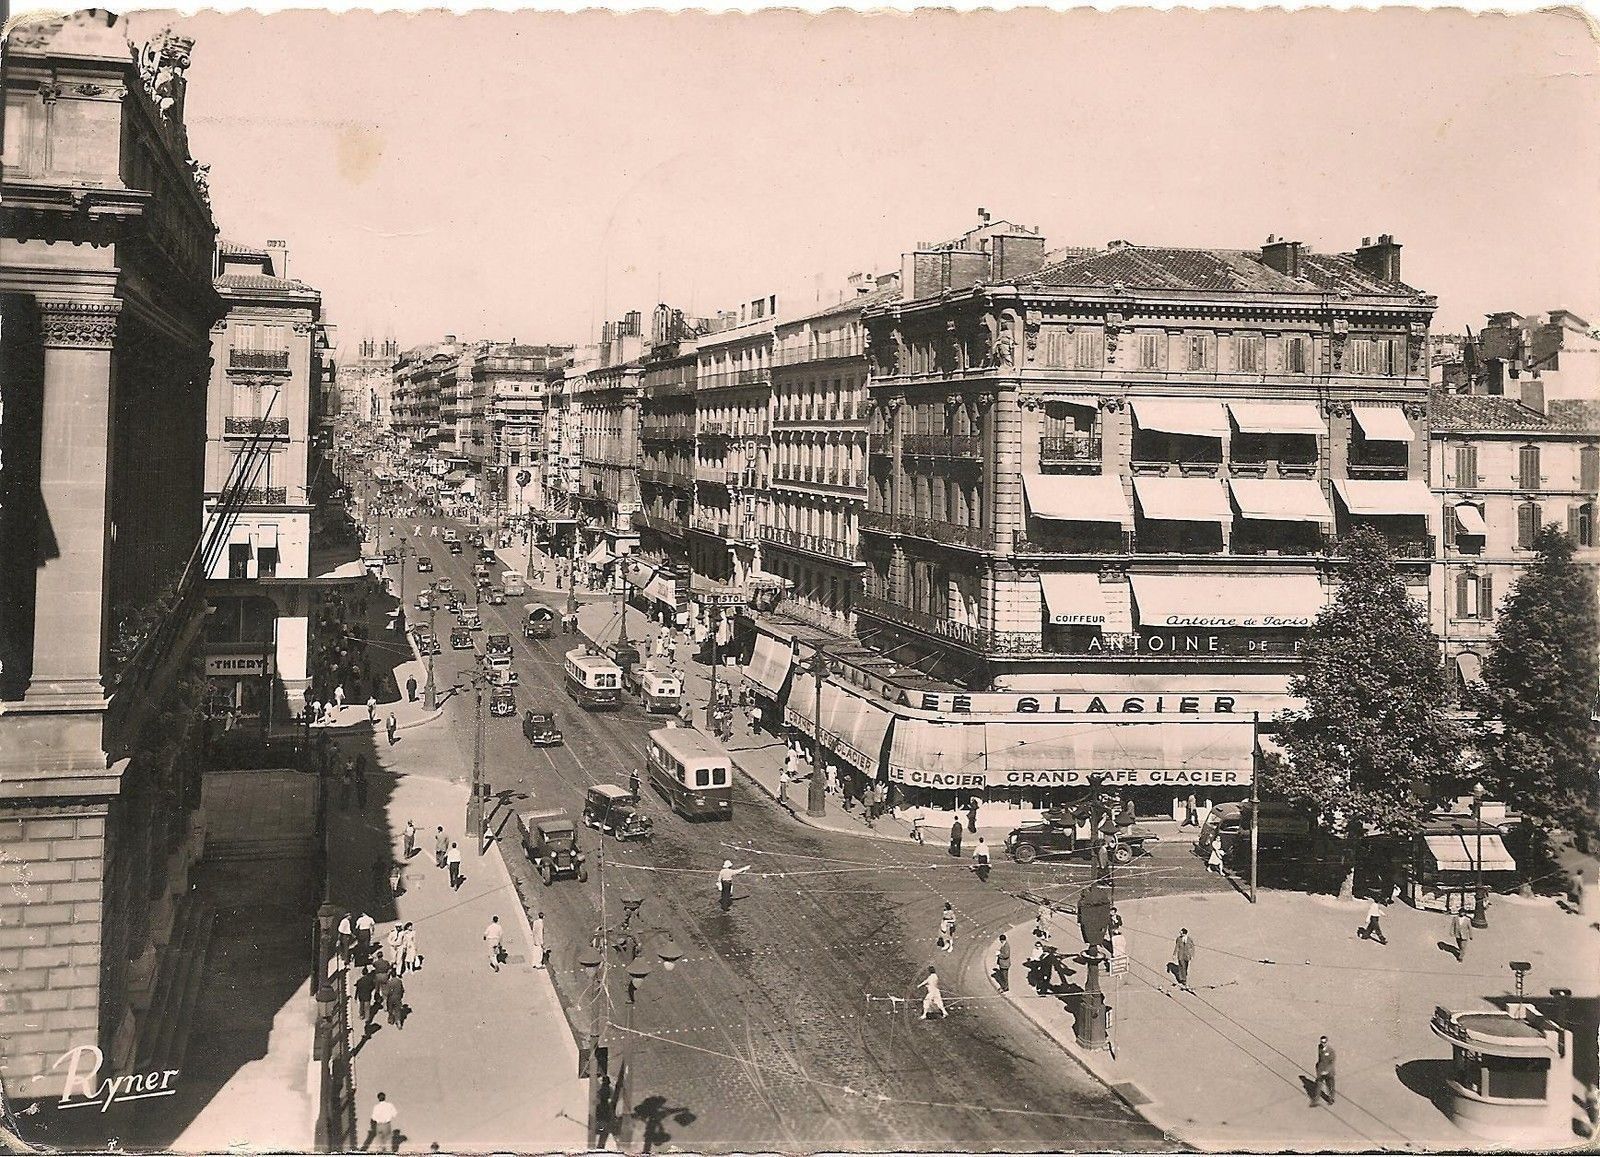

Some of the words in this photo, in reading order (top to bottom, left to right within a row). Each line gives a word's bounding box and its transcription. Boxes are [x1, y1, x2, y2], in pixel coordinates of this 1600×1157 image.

[706, 595, 745, 603] BISTOL
[1055, 615, 1106, 624] COIFFEUR
[1166, 615, 1236, 626] Antoine
[1243, 616, 1258, 626] de
[1261, 615, 1309, 626] Paris
[935, 619, 978, 645] ANTOINE
[1088, 635, 1219, 651] ANTOINE
[1248, 640, 1268, 651] DE
[1016, 696, 1237, 714] GLACIER
[889, 766, 904, 780] LE
[911, 772, 984, 787] GLACIER
[1006, 771, 1080, 783] GRAND
[1149, 771, 1238, 783] GLACIER
